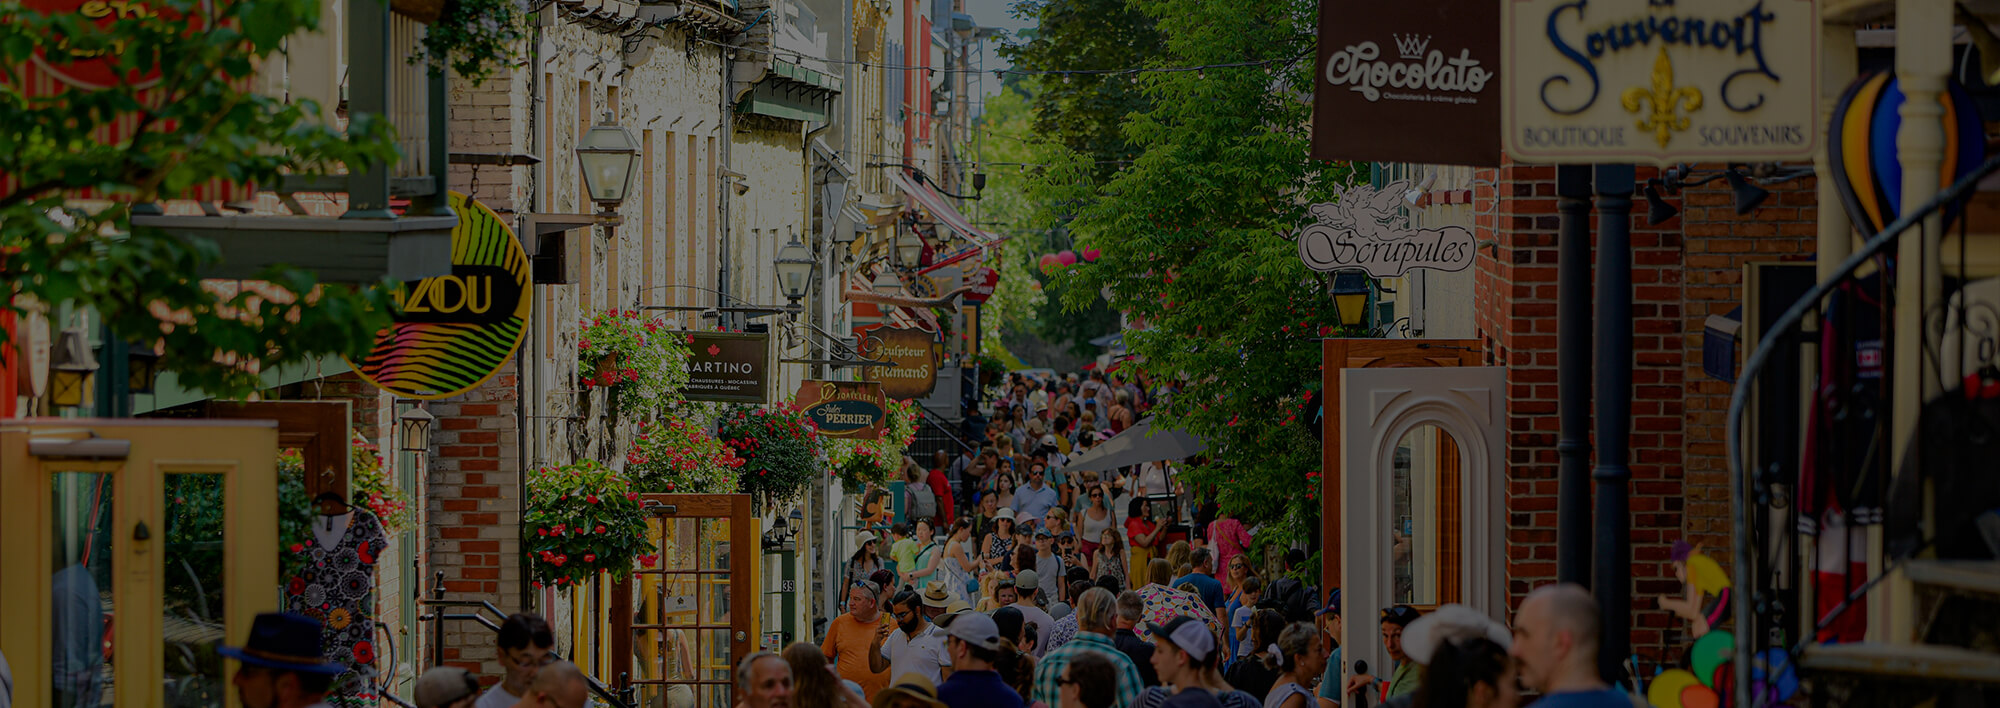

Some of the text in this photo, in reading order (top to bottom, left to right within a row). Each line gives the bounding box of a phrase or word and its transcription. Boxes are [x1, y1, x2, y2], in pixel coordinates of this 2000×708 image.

[1326, 41, 1494, 102] Chocolato
[1523, 125, 1804, 147] BOUTIQUE SOUVENIRS
[1306, 230, 1468, 274] Scrupules
[383, 274, 493, 314] ZOU
[875, 344, 926, 358] Sculpteur
[871, 364, 929, 379] Flamand
[826, 413, 875, 429] PERRIER
[783, 580, 794, 592] 39
